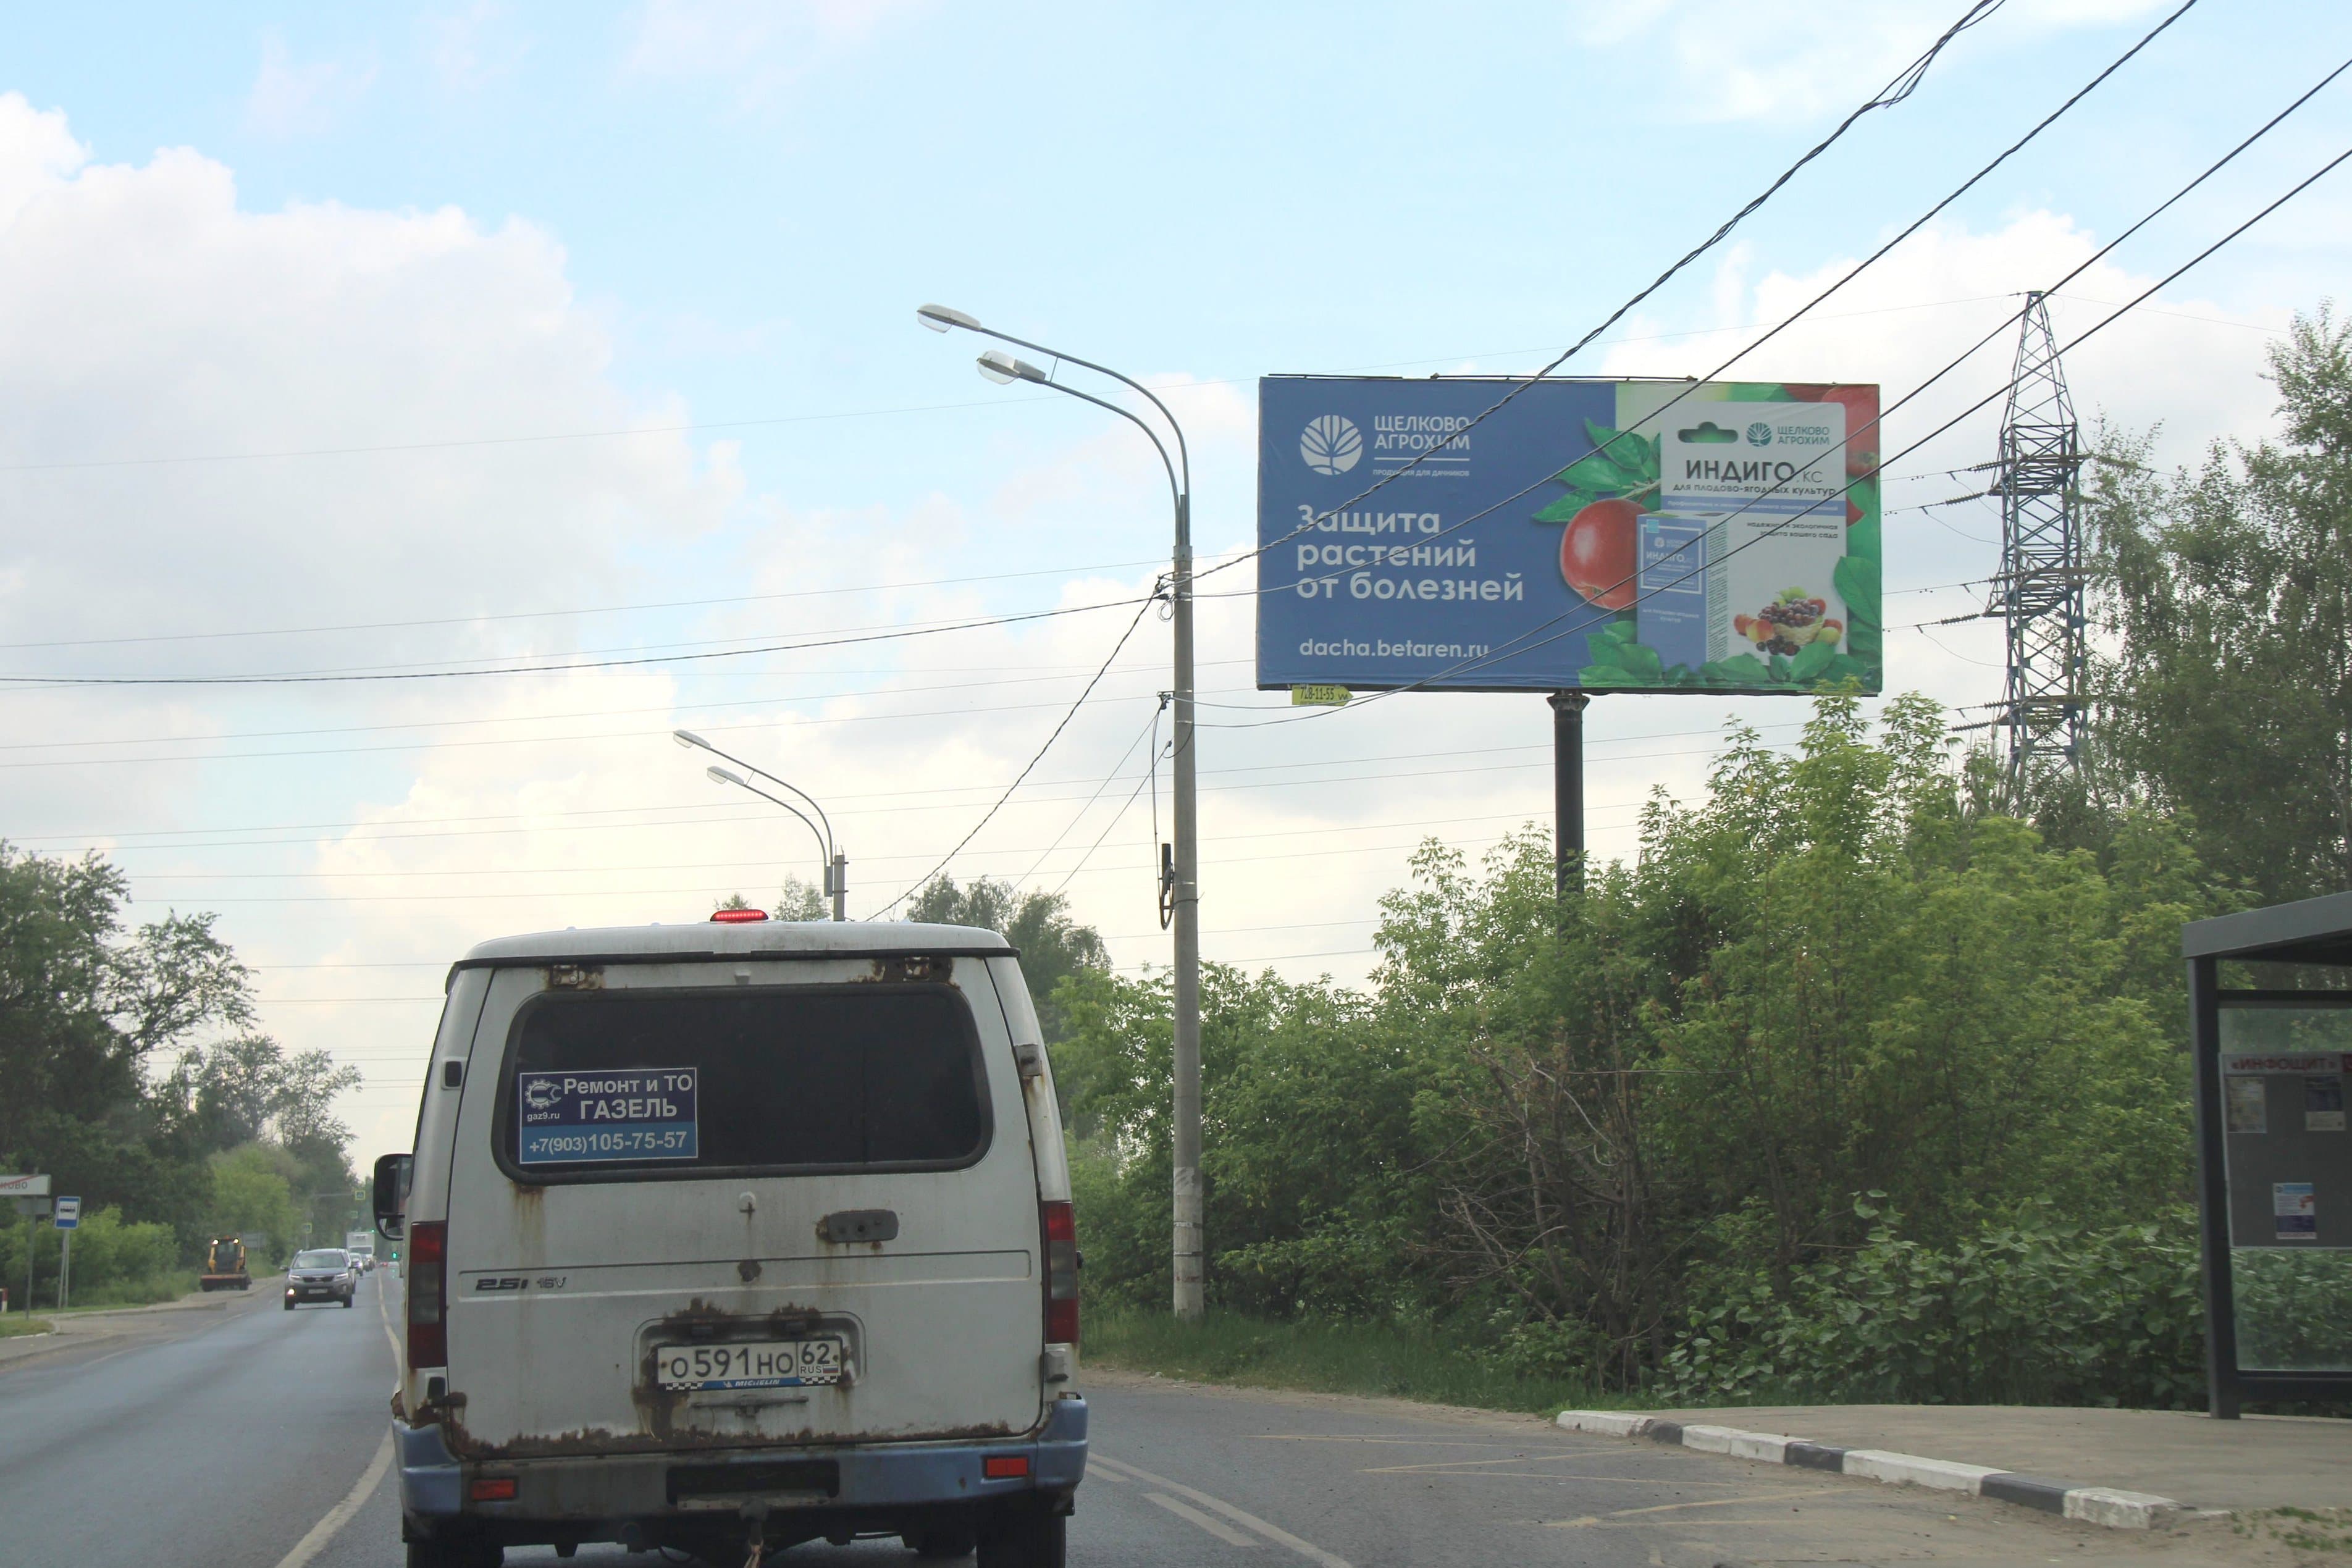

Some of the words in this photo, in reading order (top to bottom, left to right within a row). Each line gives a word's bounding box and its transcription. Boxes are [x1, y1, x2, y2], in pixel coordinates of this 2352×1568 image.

[1374, 416, 1470, 432] ЩЕЛКОВО
[1777, 426, 1829, 435] ЩЕЛКОВО
[1374, 434, 1470, 450] АГРОХИМ
[1778, 436, 1829, 445] АГРОХИМ
[1802, 471, 1823, 483] КС
[1792, 487, 1836, 497] культур
[1297, 504, 1440, 535] Защита
[1297, 539, 1476, 571] растений
[1297, 577, 1339, 598] от
[1350, 572, 1524, 601] болезней
[1299, 639, 1489, 658] dacha.betaren.ru
[564, 1078, 640, 1095] Ремонт
[647, 1080, 658, 1092] и
[665, 1075, 692, 1092] ТО
[527, 1112, 560, 1121] gaz9.ru
[581, 1098, 678, 1120] ГАЗЕЛЬ
[801, 1343, 831, 1365] 62
[800, 1365, 822, 1374] RUS
[734, 1379, 780, 1387] MICHELIN
